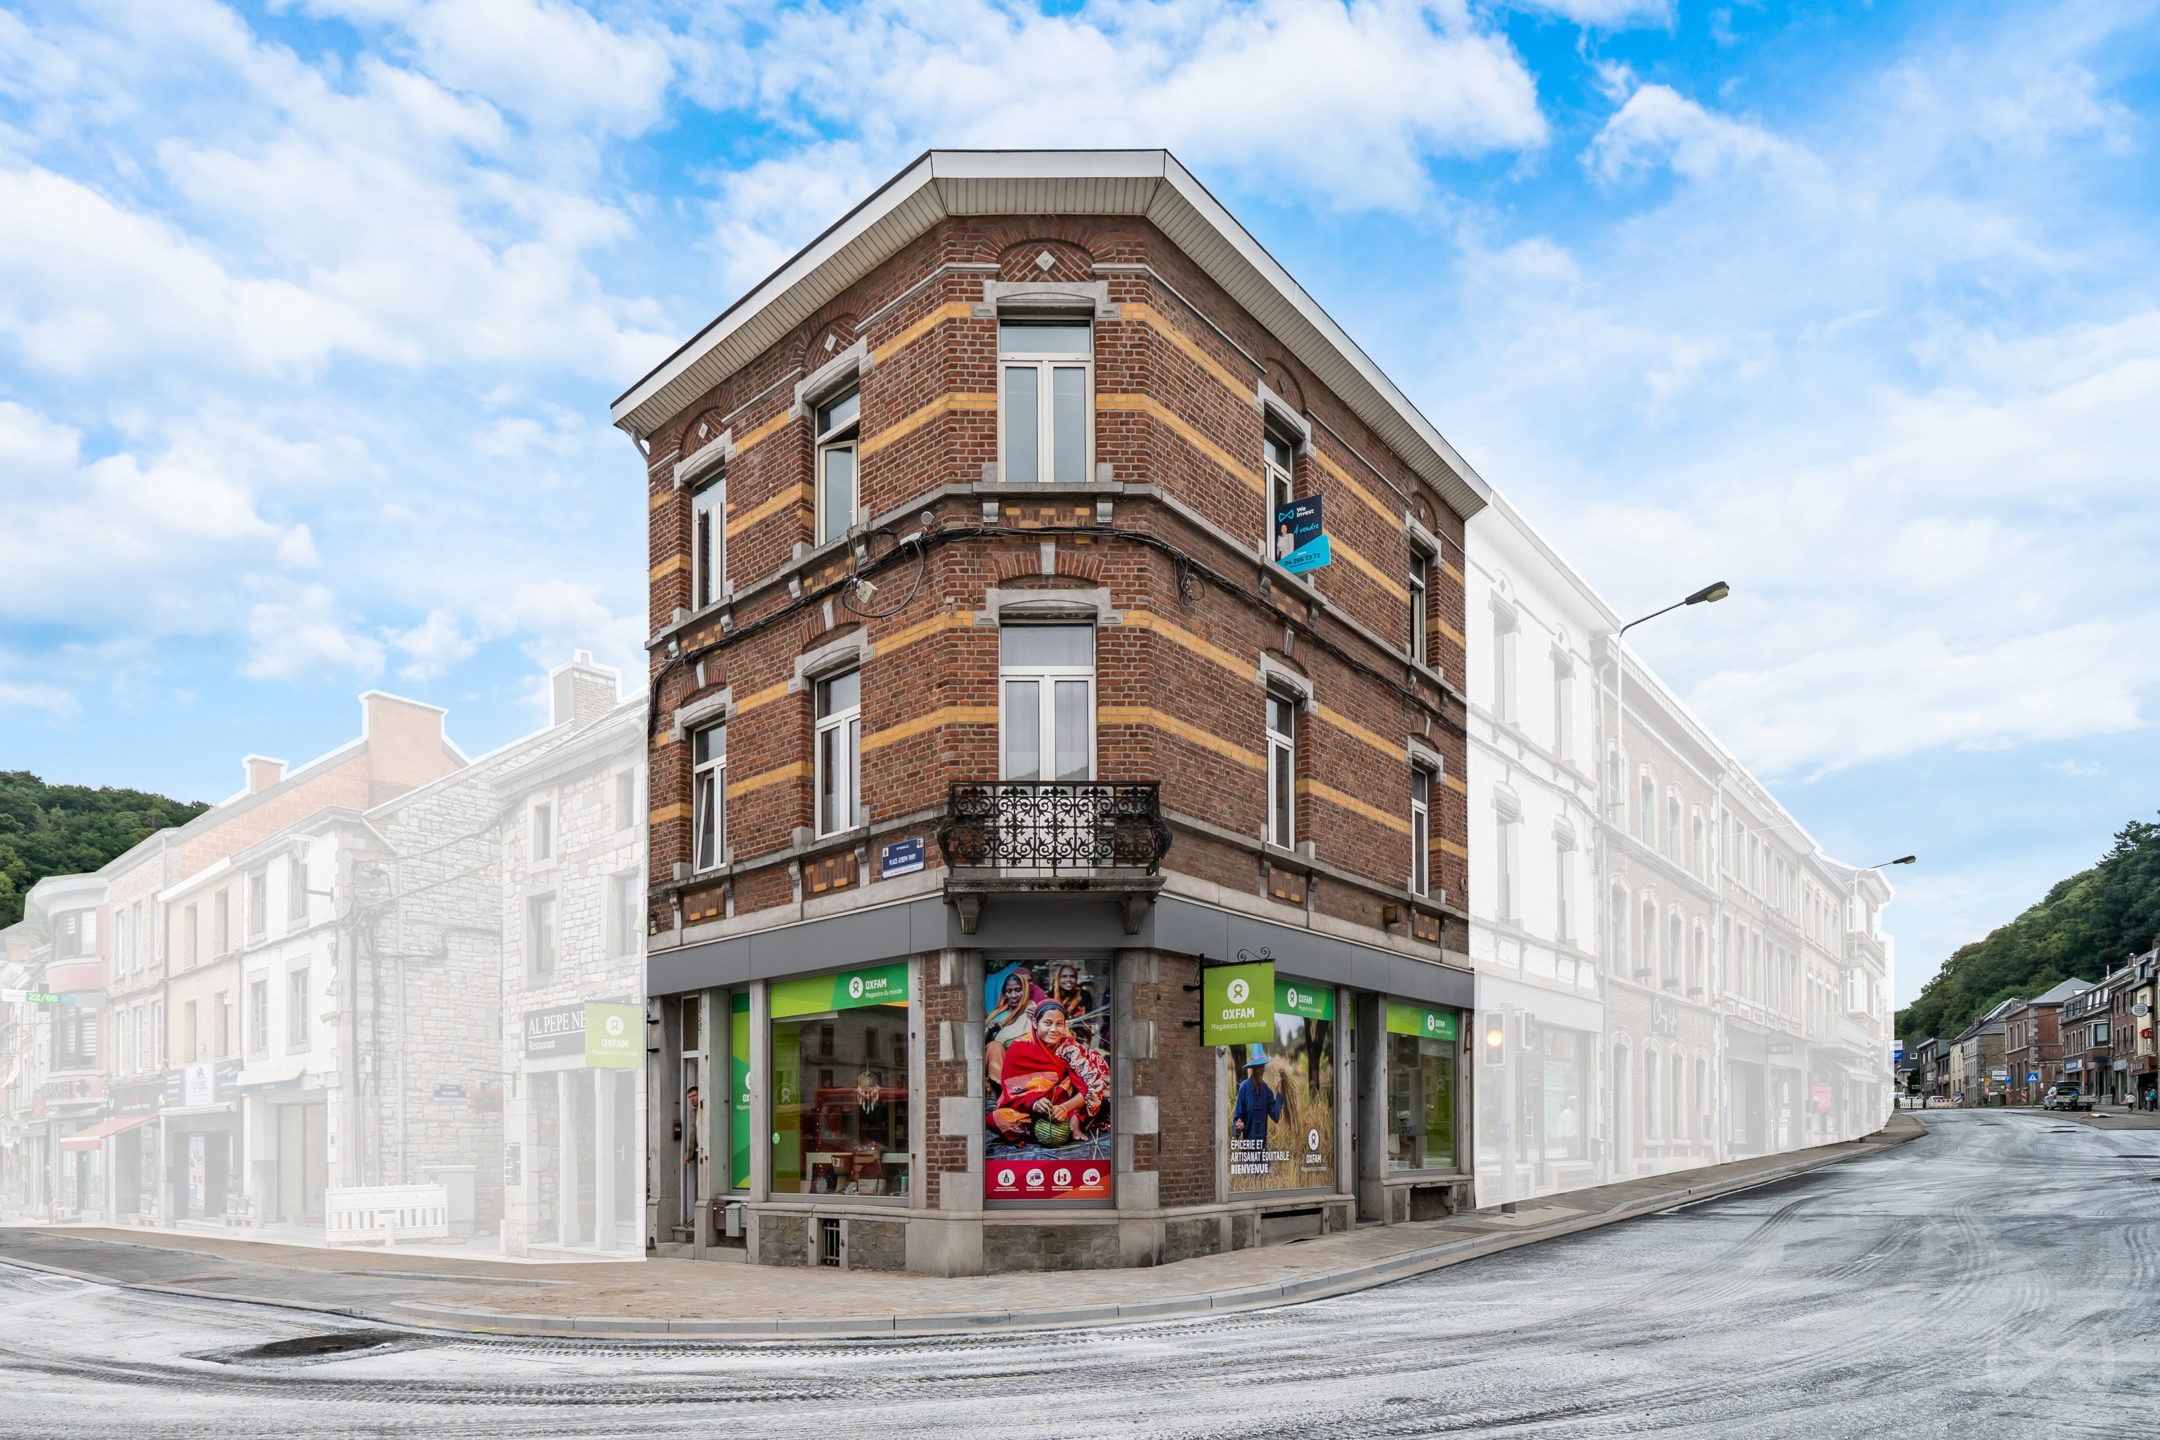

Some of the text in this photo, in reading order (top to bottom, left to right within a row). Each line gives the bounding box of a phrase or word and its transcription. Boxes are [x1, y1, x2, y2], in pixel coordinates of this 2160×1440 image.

[1300, 523, 1319, 533] vendre
[865, 978, 887, 990] OXFAM
[28, 993, 58, 1003] 22/08
[1298, 994, 1313, 1005] OXFAM
[1222, 1007, 1255, 1020] OXFAM
[528, 1018, 542, 1035] AL
[544, 1013, 569, 1033] PEPE
[1211, 1022, 1238, 1031] Magasins
[1247, 1020, 1267, 1028] monde
[1435, 1020, 1445, 1028] OXFAM
[528, 1039, 555, 1051] Restaurant
[601, 1038, 628, 1048] OXFAM
[1230, 1137, 1264, 1150] ÉPICERIE ET
[1230, 1148, 1290, 1162] ARTISANAT ÉQUITABLE
[1306, 1154, 1322, 1164] OXFAM
[1230, 1164, 1268, 1175] BIENVENUE
